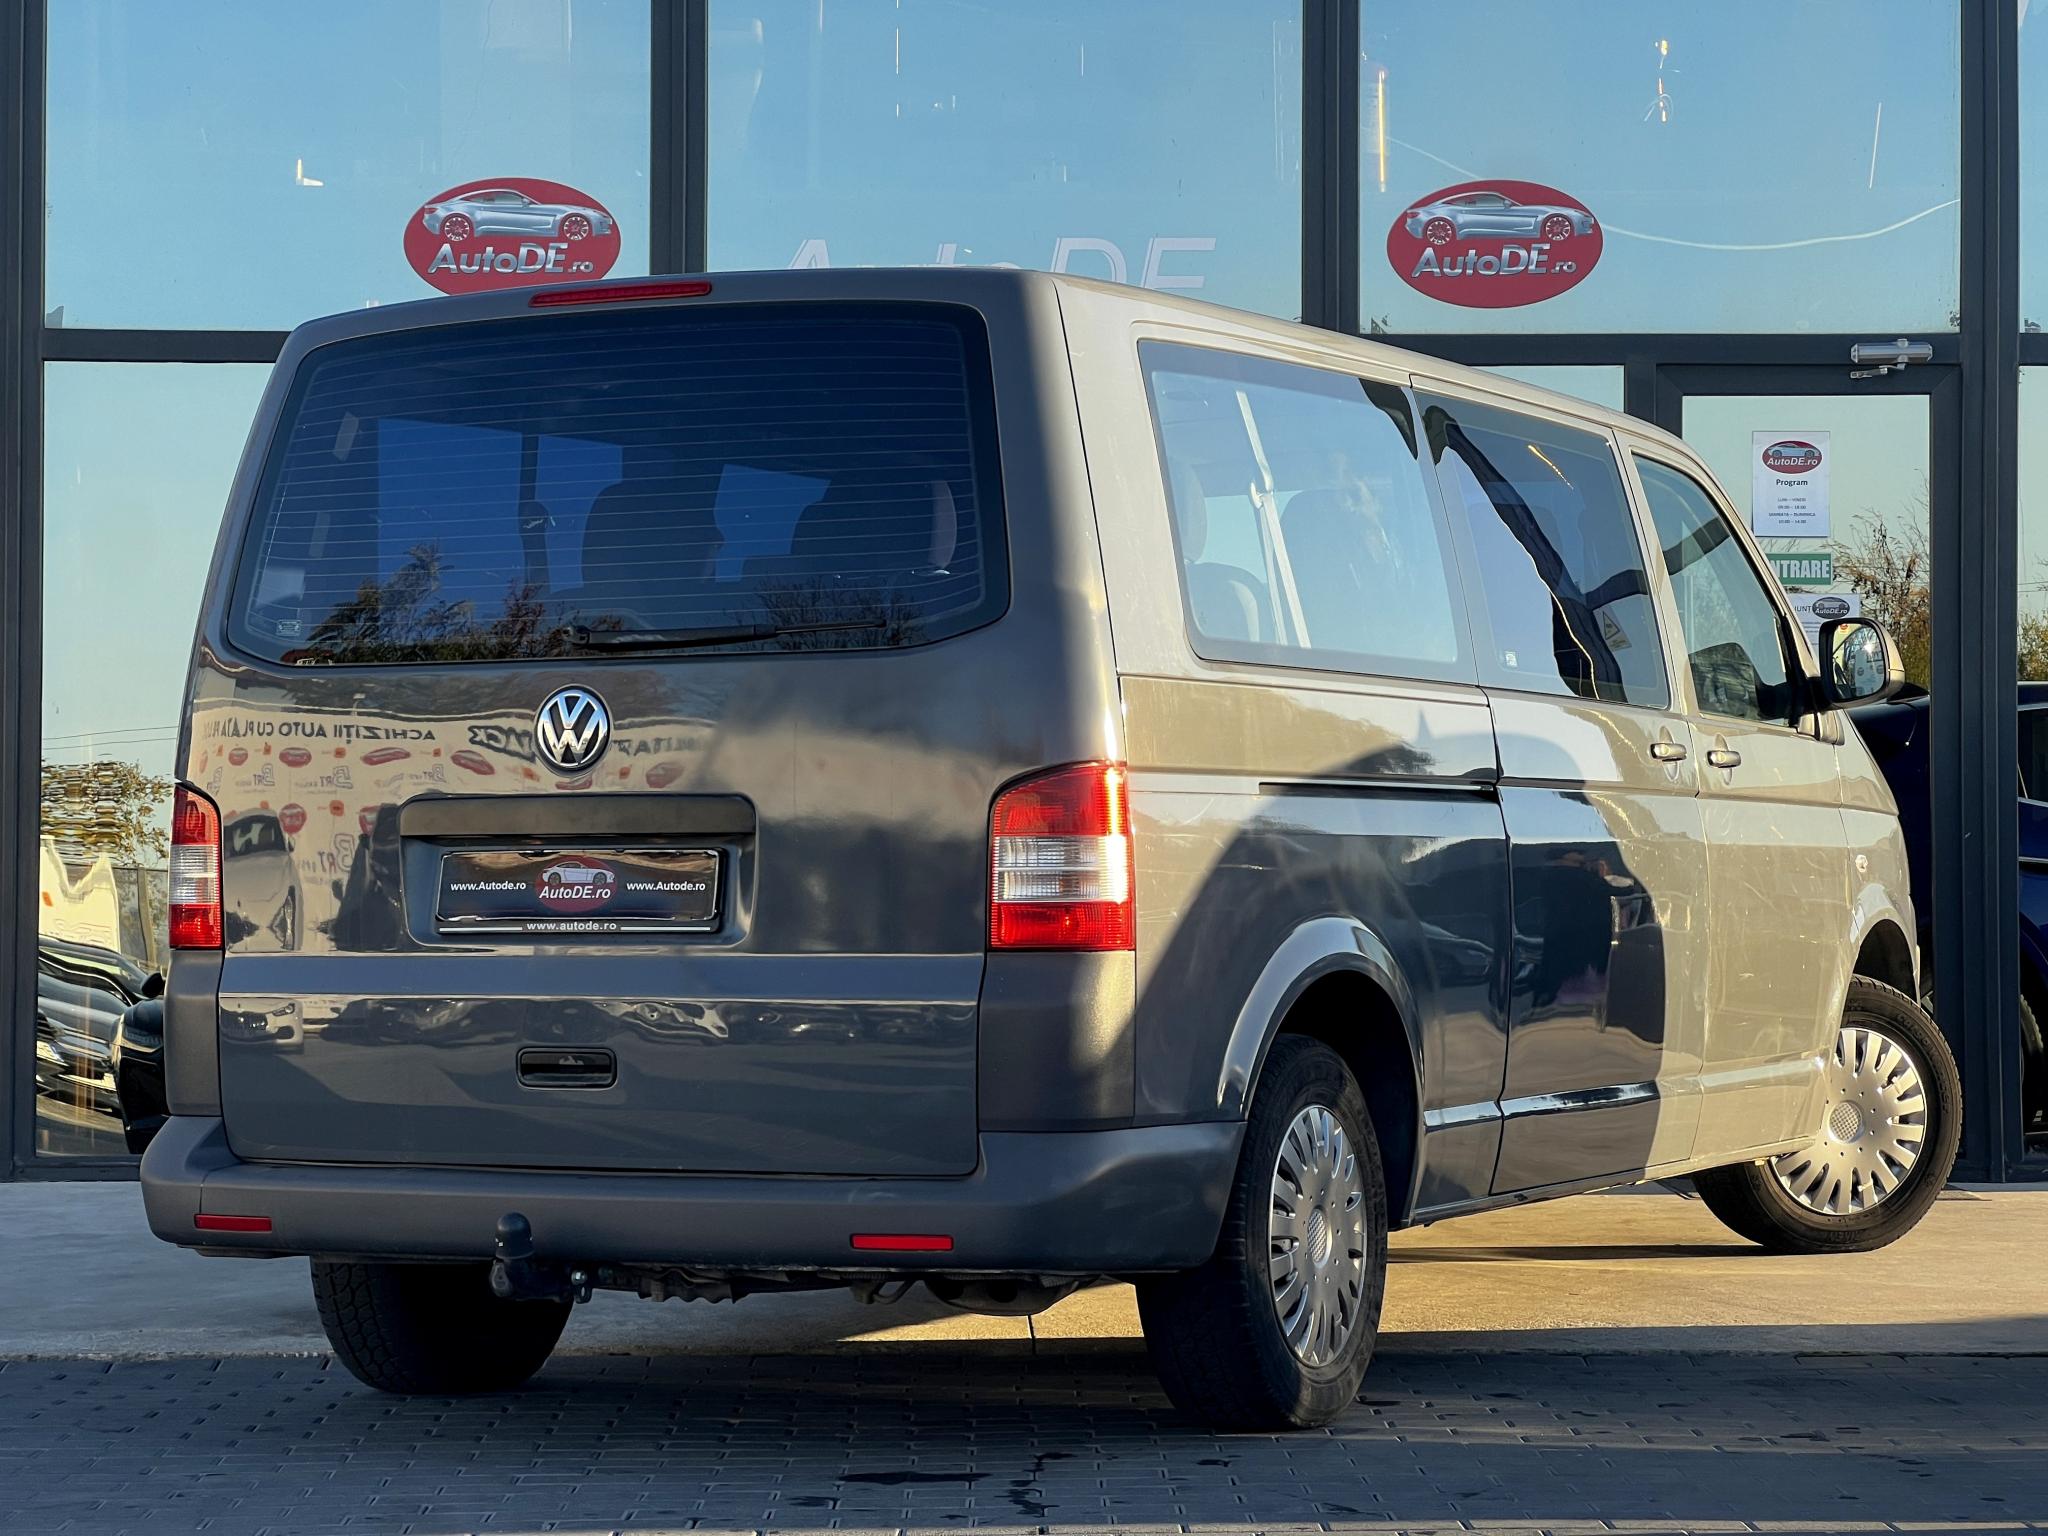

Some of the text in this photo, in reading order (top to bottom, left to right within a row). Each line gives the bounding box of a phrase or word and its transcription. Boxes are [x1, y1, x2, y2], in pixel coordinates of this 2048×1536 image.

[1766, 457, 1818, 466] AutoDE.ro
[1775, 478, 1808, 487] Program
[1769, 559, 1829, 578] NTRARE
[450, 880, 526, 891] www.Autode.ro
[626, 881, 706, 891] www.Autode.ro
[539, 885, 611, 899] AutoDE.ro
[526, 921, 617, 931] www.autode.ro
